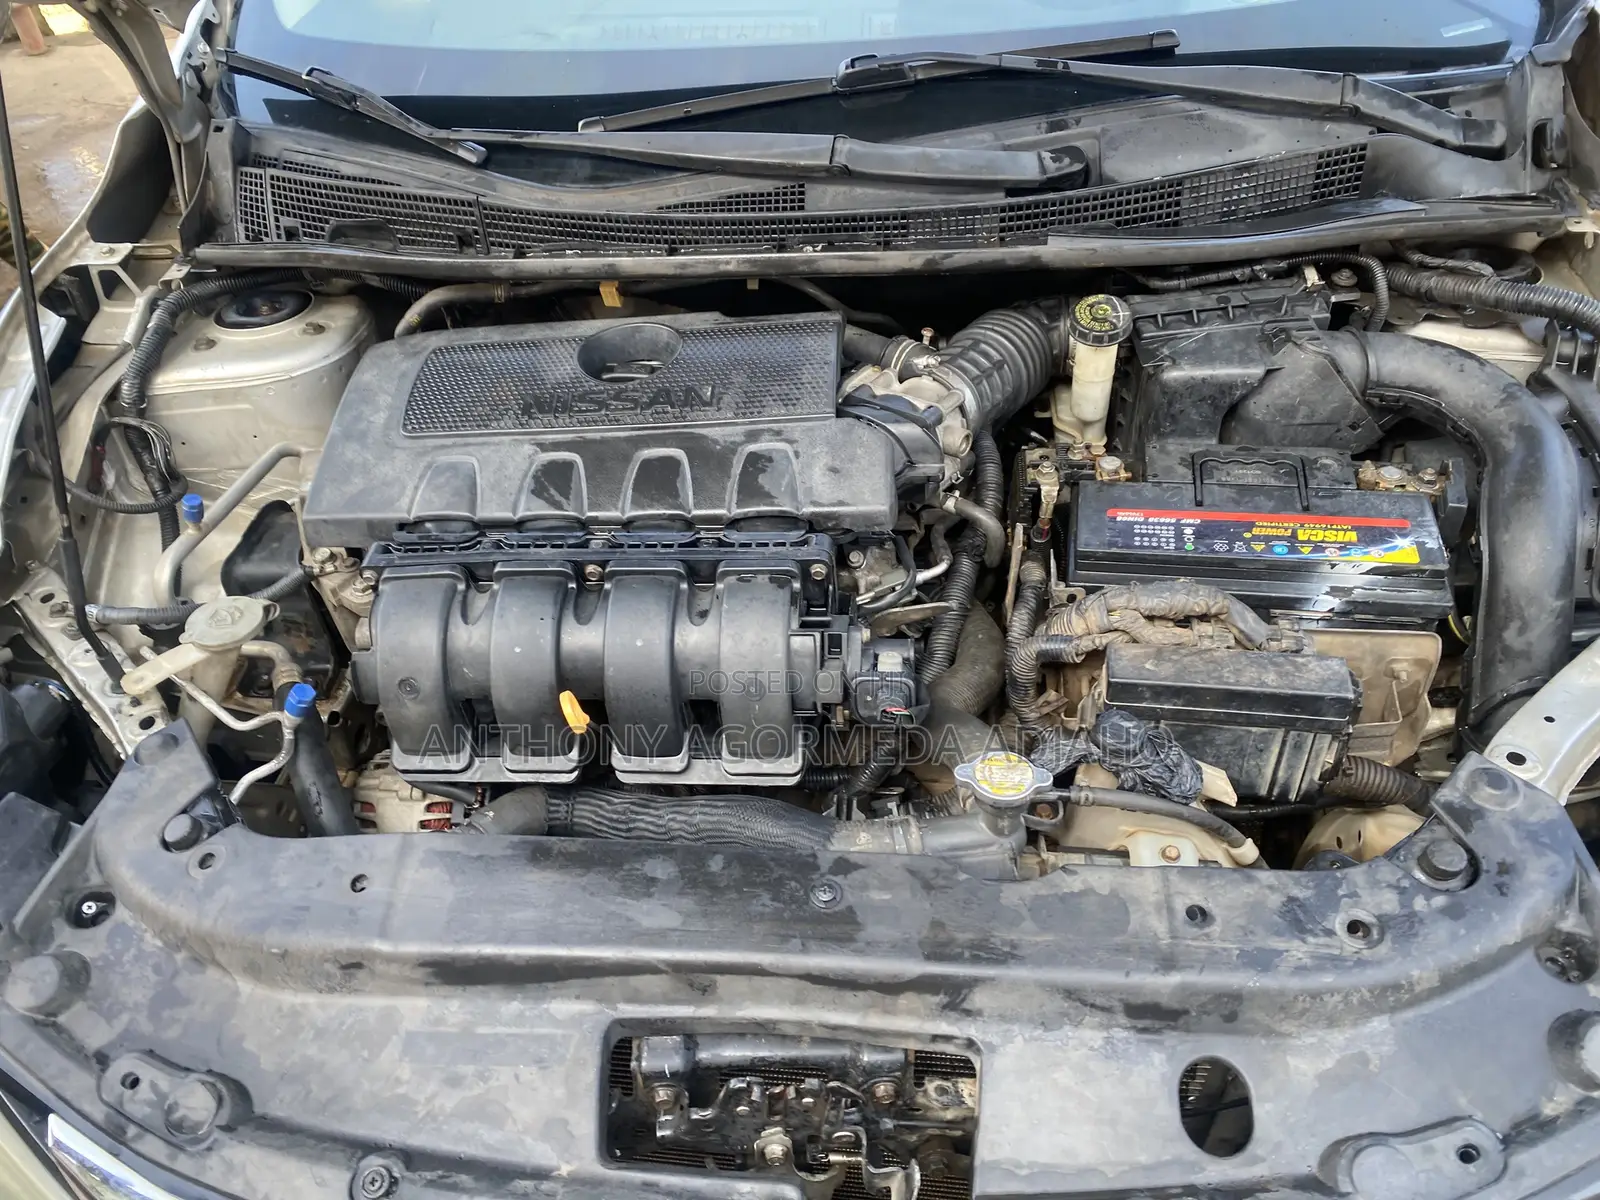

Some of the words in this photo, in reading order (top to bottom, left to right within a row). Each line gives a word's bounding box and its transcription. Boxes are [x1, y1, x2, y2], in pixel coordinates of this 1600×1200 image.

[521, 384, 719, 419] NISSAN
[1251, 527, 1293, 537] POWER
[1297, 529, 1358, 542] VISCA
